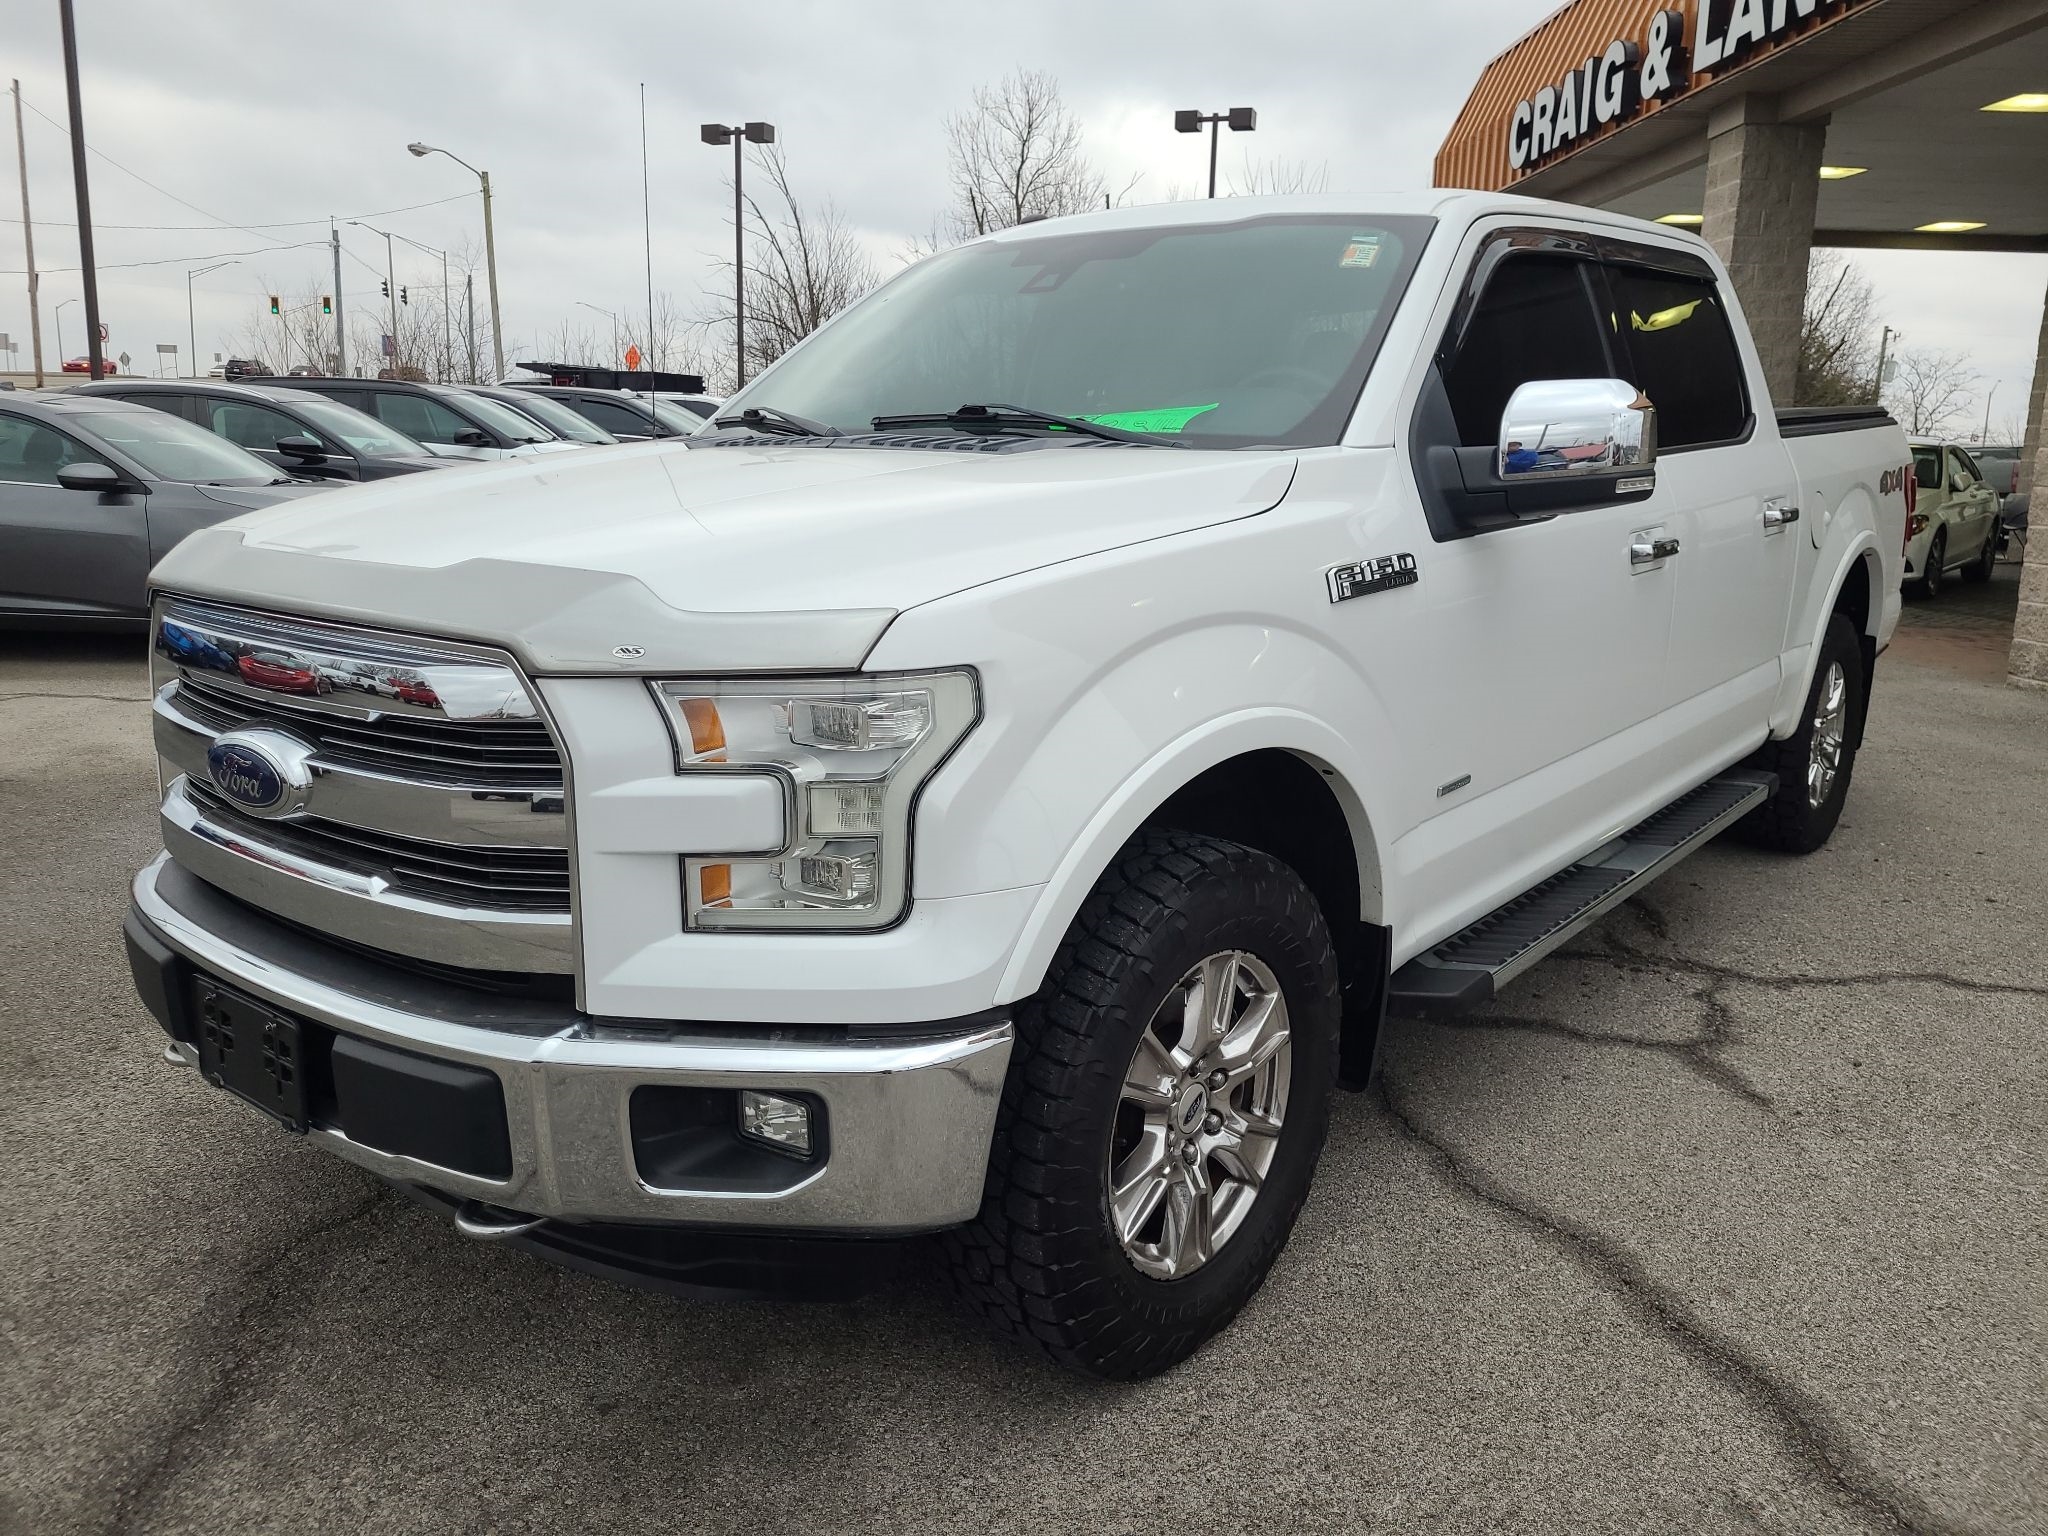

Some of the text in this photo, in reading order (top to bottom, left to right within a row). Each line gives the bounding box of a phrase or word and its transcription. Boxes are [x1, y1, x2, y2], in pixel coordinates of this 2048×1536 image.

[1509, 0, 1817, 170] CRAIG & LA
[220, 752, 264, 799] Ford
